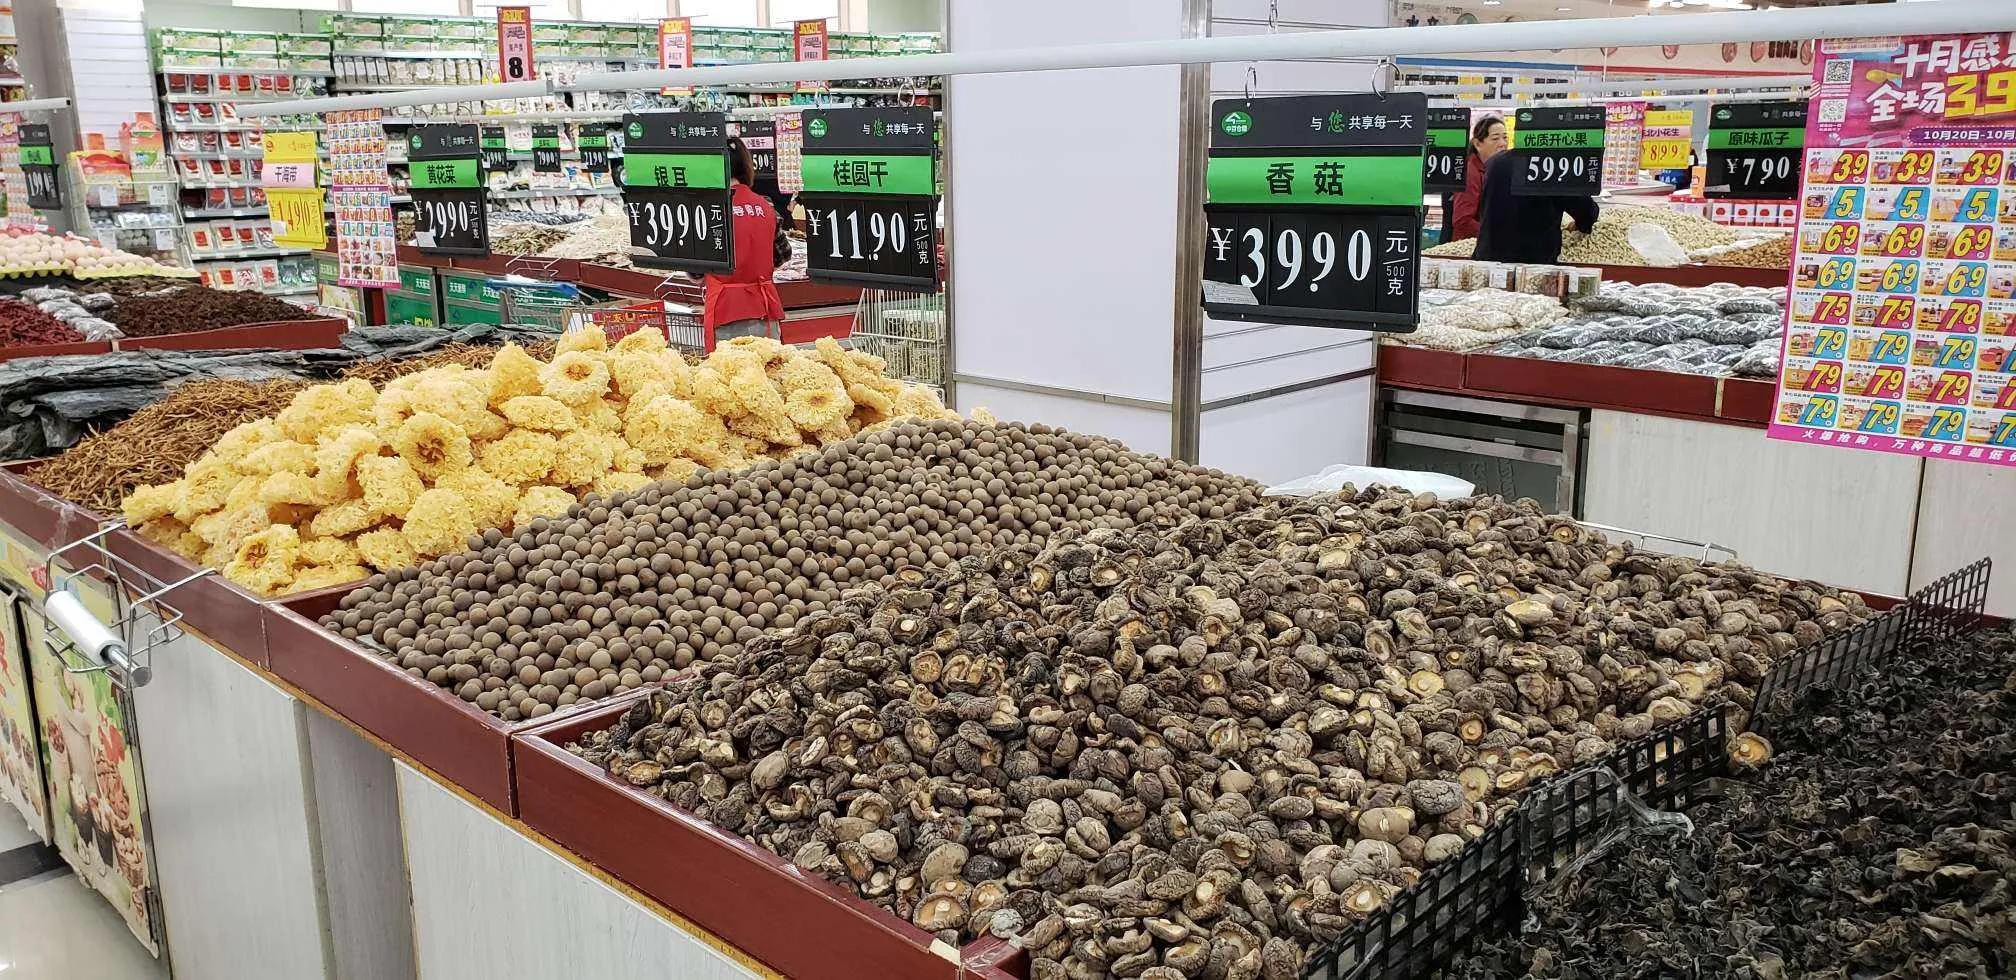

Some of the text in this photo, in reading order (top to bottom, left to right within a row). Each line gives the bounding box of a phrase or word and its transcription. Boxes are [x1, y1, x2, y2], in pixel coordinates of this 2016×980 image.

[509, 57, 523, 78] 8
[670, 122, 719, 139] 与您共享每一天
[862, 117, 925, 137] 与您共享每一天
[1310, 110, 1413, 134] 与您共享每一天
[1524, 132, 1588, 147] 优质开心果
[1728, 131, 1790, 146] 原味瓜子
[1923, 130, 2016, 141] 10月20日-10月
[427, 164, 457, 184] 黄花菜
[654, 165, 689, 187] 银耳
[833, 160, 889, 187] 桂圆干
[1266, 162, 1346, 196] 香菇
[1835, 189, 1858, 217] 5
[1899, 190, 1922, 218] 5
[1966, 191, 1990, 220] 5
